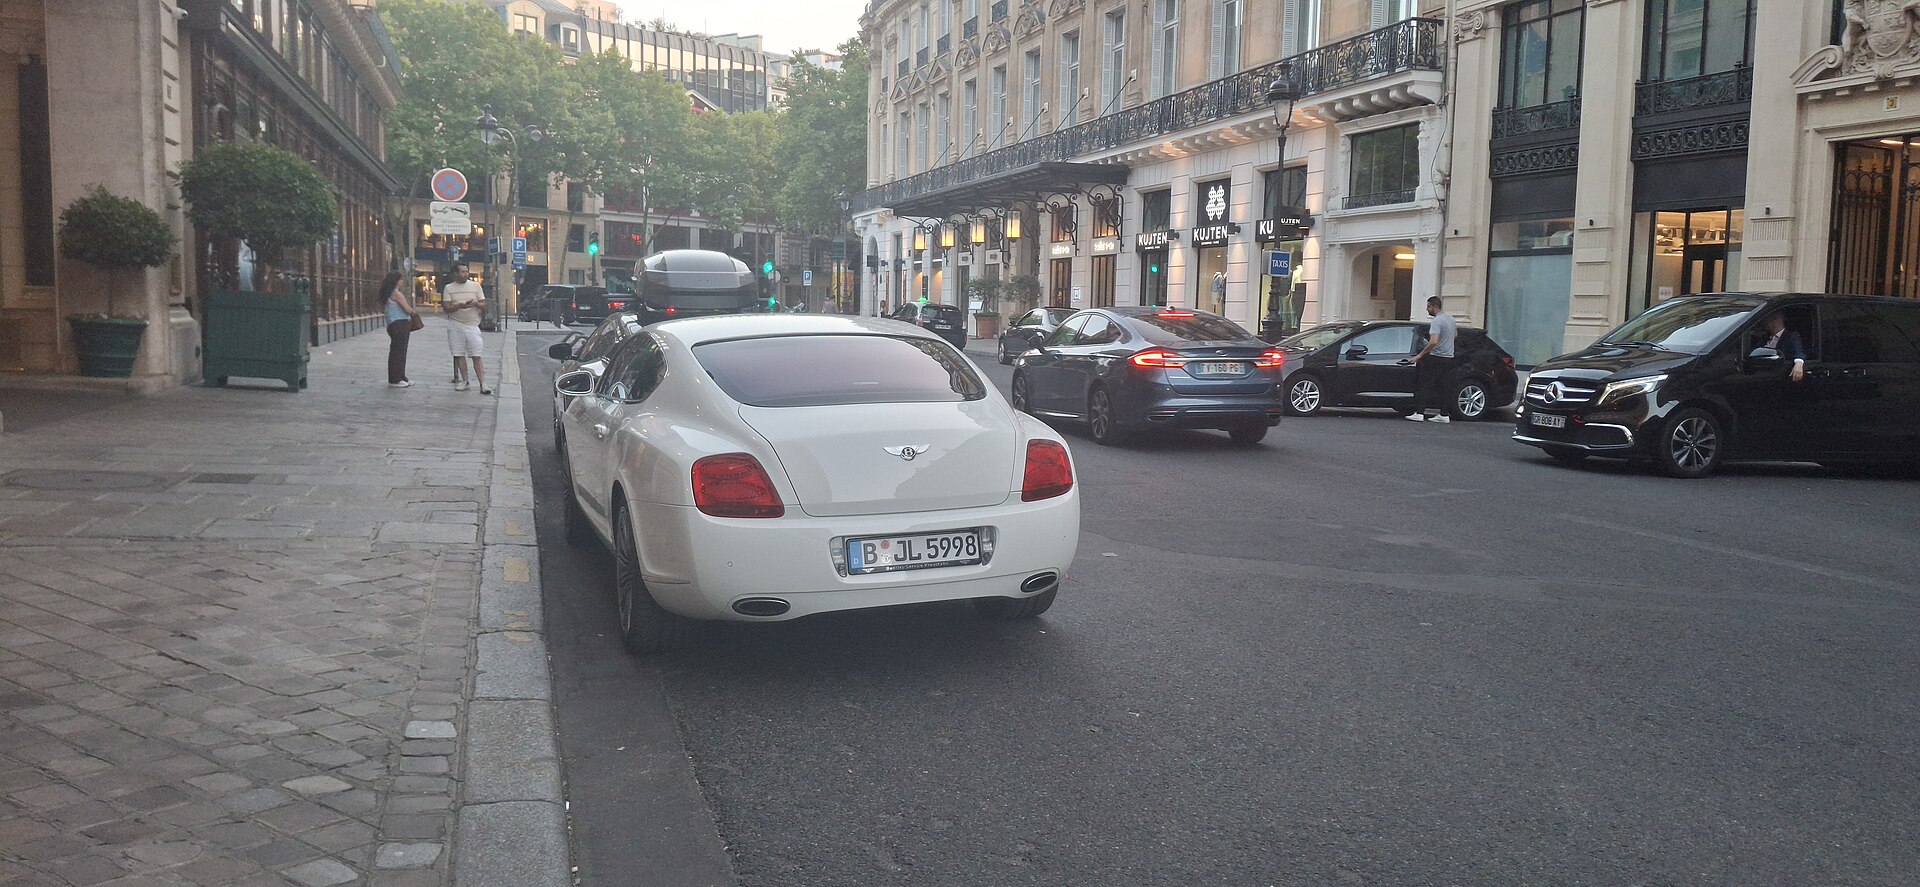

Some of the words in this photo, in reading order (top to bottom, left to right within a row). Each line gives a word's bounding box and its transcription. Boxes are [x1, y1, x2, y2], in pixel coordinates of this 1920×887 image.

[1138, 231, 1168, 246] KUJTEN
[1193, 225, 1228, 241] KUJTEN
[516, 240, 523, 249] P
[1272, 259, 1289, 269] TAXIS
[863, 542, 878, 564] B
[894, 539, 922, 562] JL
[926, 534, 977, 559] 5998
